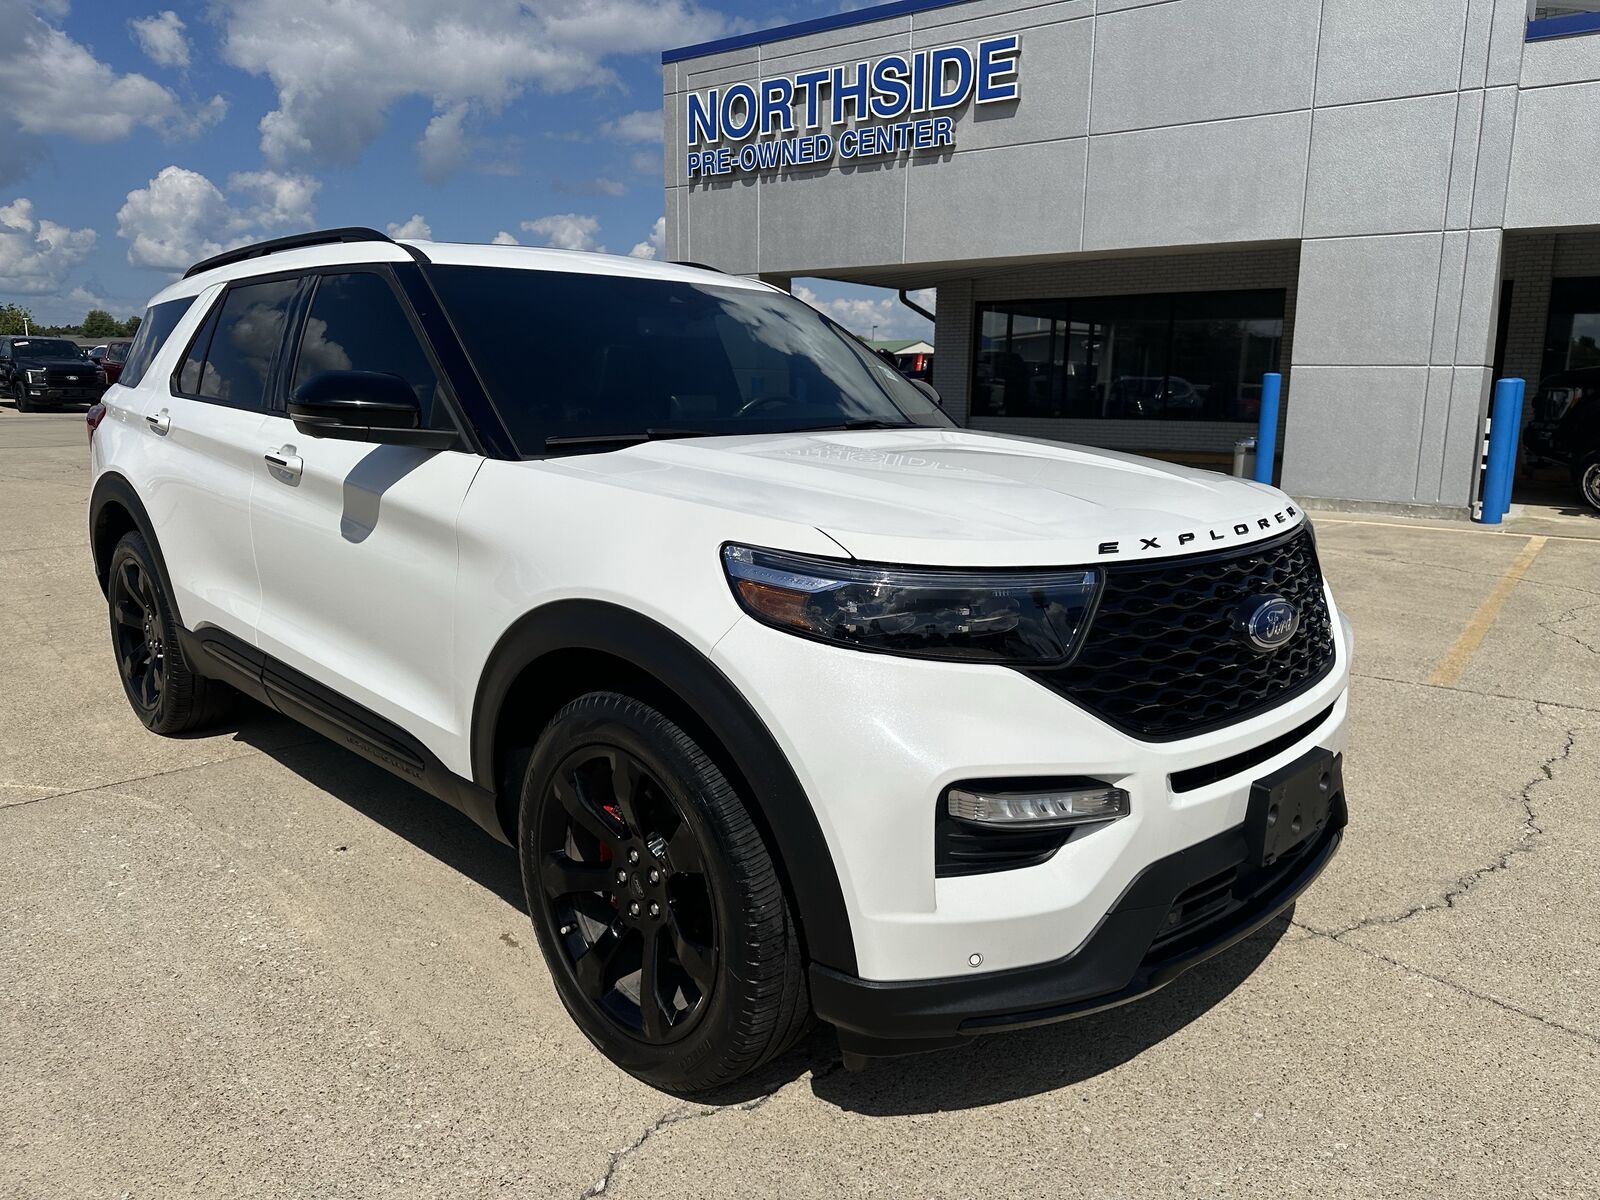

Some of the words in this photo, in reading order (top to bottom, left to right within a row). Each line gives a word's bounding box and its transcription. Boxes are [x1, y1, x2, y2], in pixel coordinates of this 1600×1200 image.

[687, 34, 1019, 146] NORTHSIDE
[688, 133, 833, 177] PRE-OWNED
[839, 116, 953, 158] CENTER
[1098, 506, 1296, 554] EXPLORER
[1266, 608, 1292, 637] Ford
